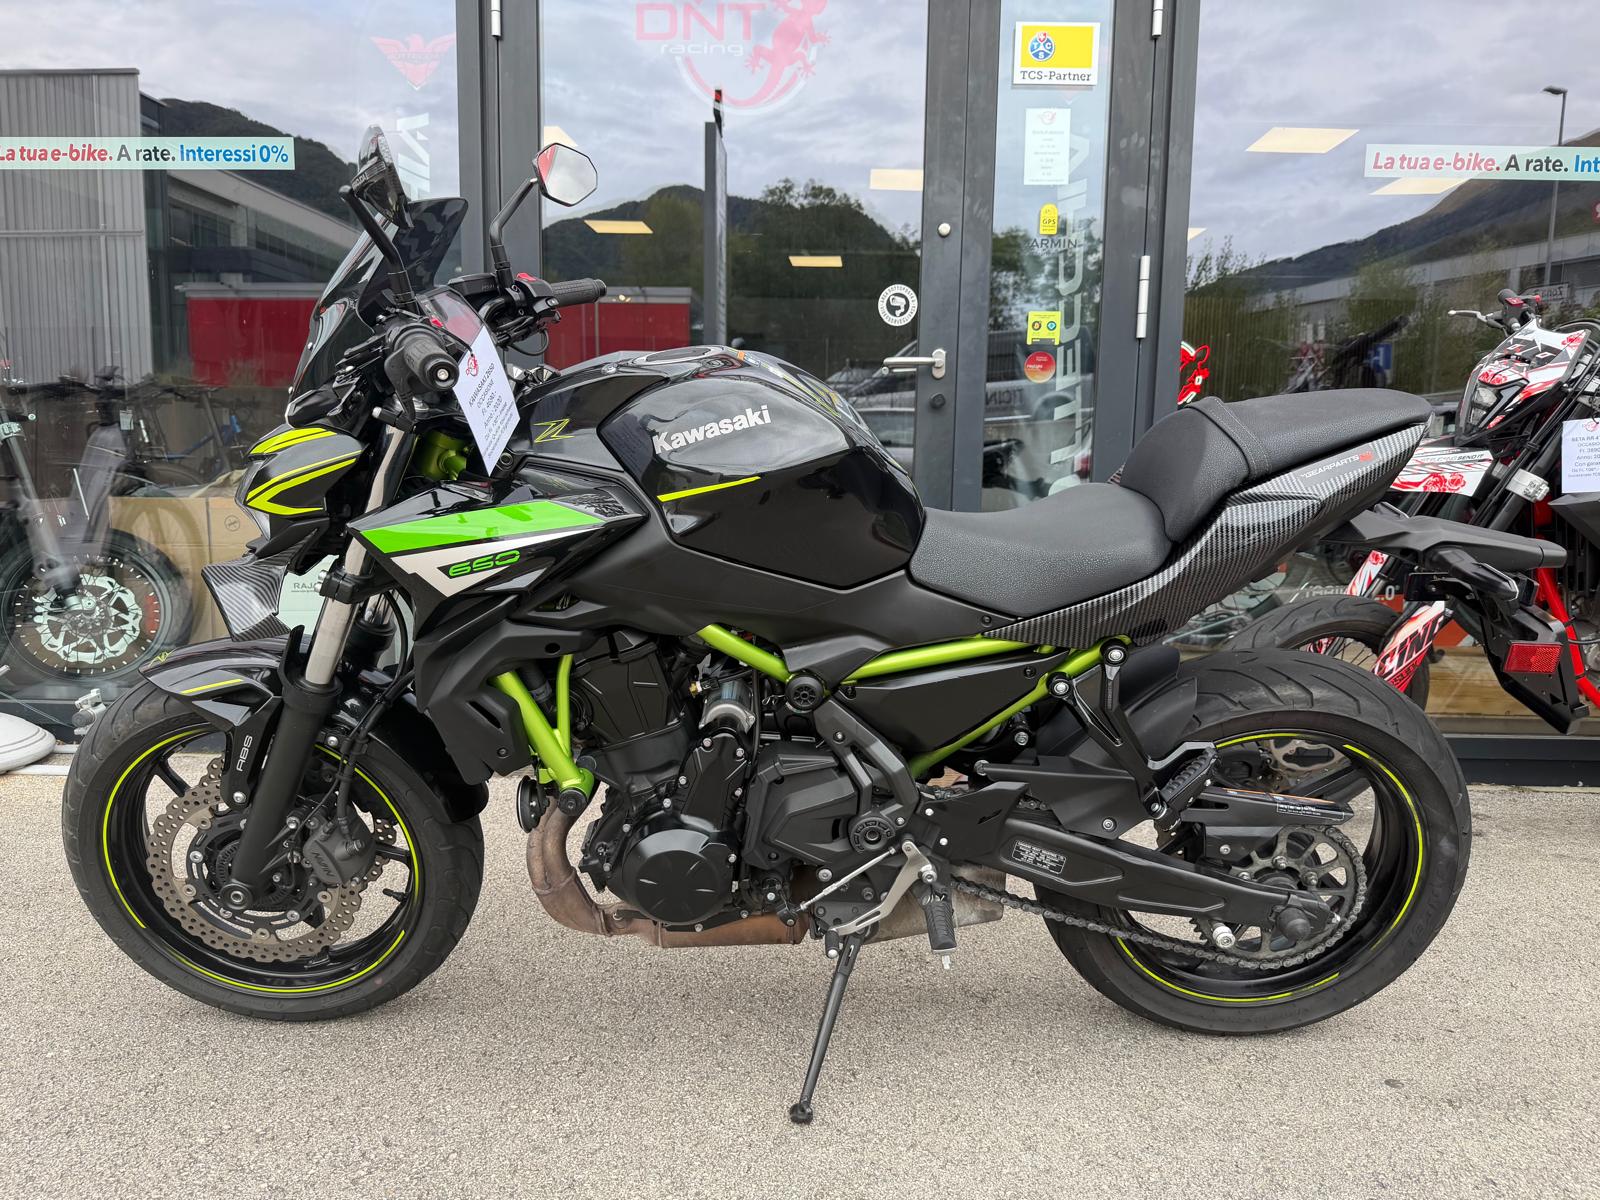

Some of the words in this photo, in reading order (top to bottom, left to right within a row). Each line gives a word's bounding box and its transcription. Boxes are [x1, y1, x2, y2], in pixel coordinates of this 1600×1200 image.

[636, 3, 766, 41] DNT
[661, 42, 744, 56] racing
[1020, 70, 1092, 81] TCS-Partner
[19, 146, 48, 162] tua
[51, 144, 113, 162] e-bike.
[117, 144, 131, 161] A
[136, 145, 176, 162] rate.
[180, 144, 256, 162] Interessi
[259, 144, 289, 163] 0%
[1373, 152, 1395, 170] La
[1399, 153, 1432, 170] tua
[1433, 152, 1500, 171] e-bike.
[1505, 154, 1520, 171] A
[1525, 155, 1569, 172] rate.
[1022, 238, 1078, 249] ARMIN
[653, 404, 772, 455] Kawasaki
[449, 550, 520, 577] 650
[236, 735, 252, 771] ABS
